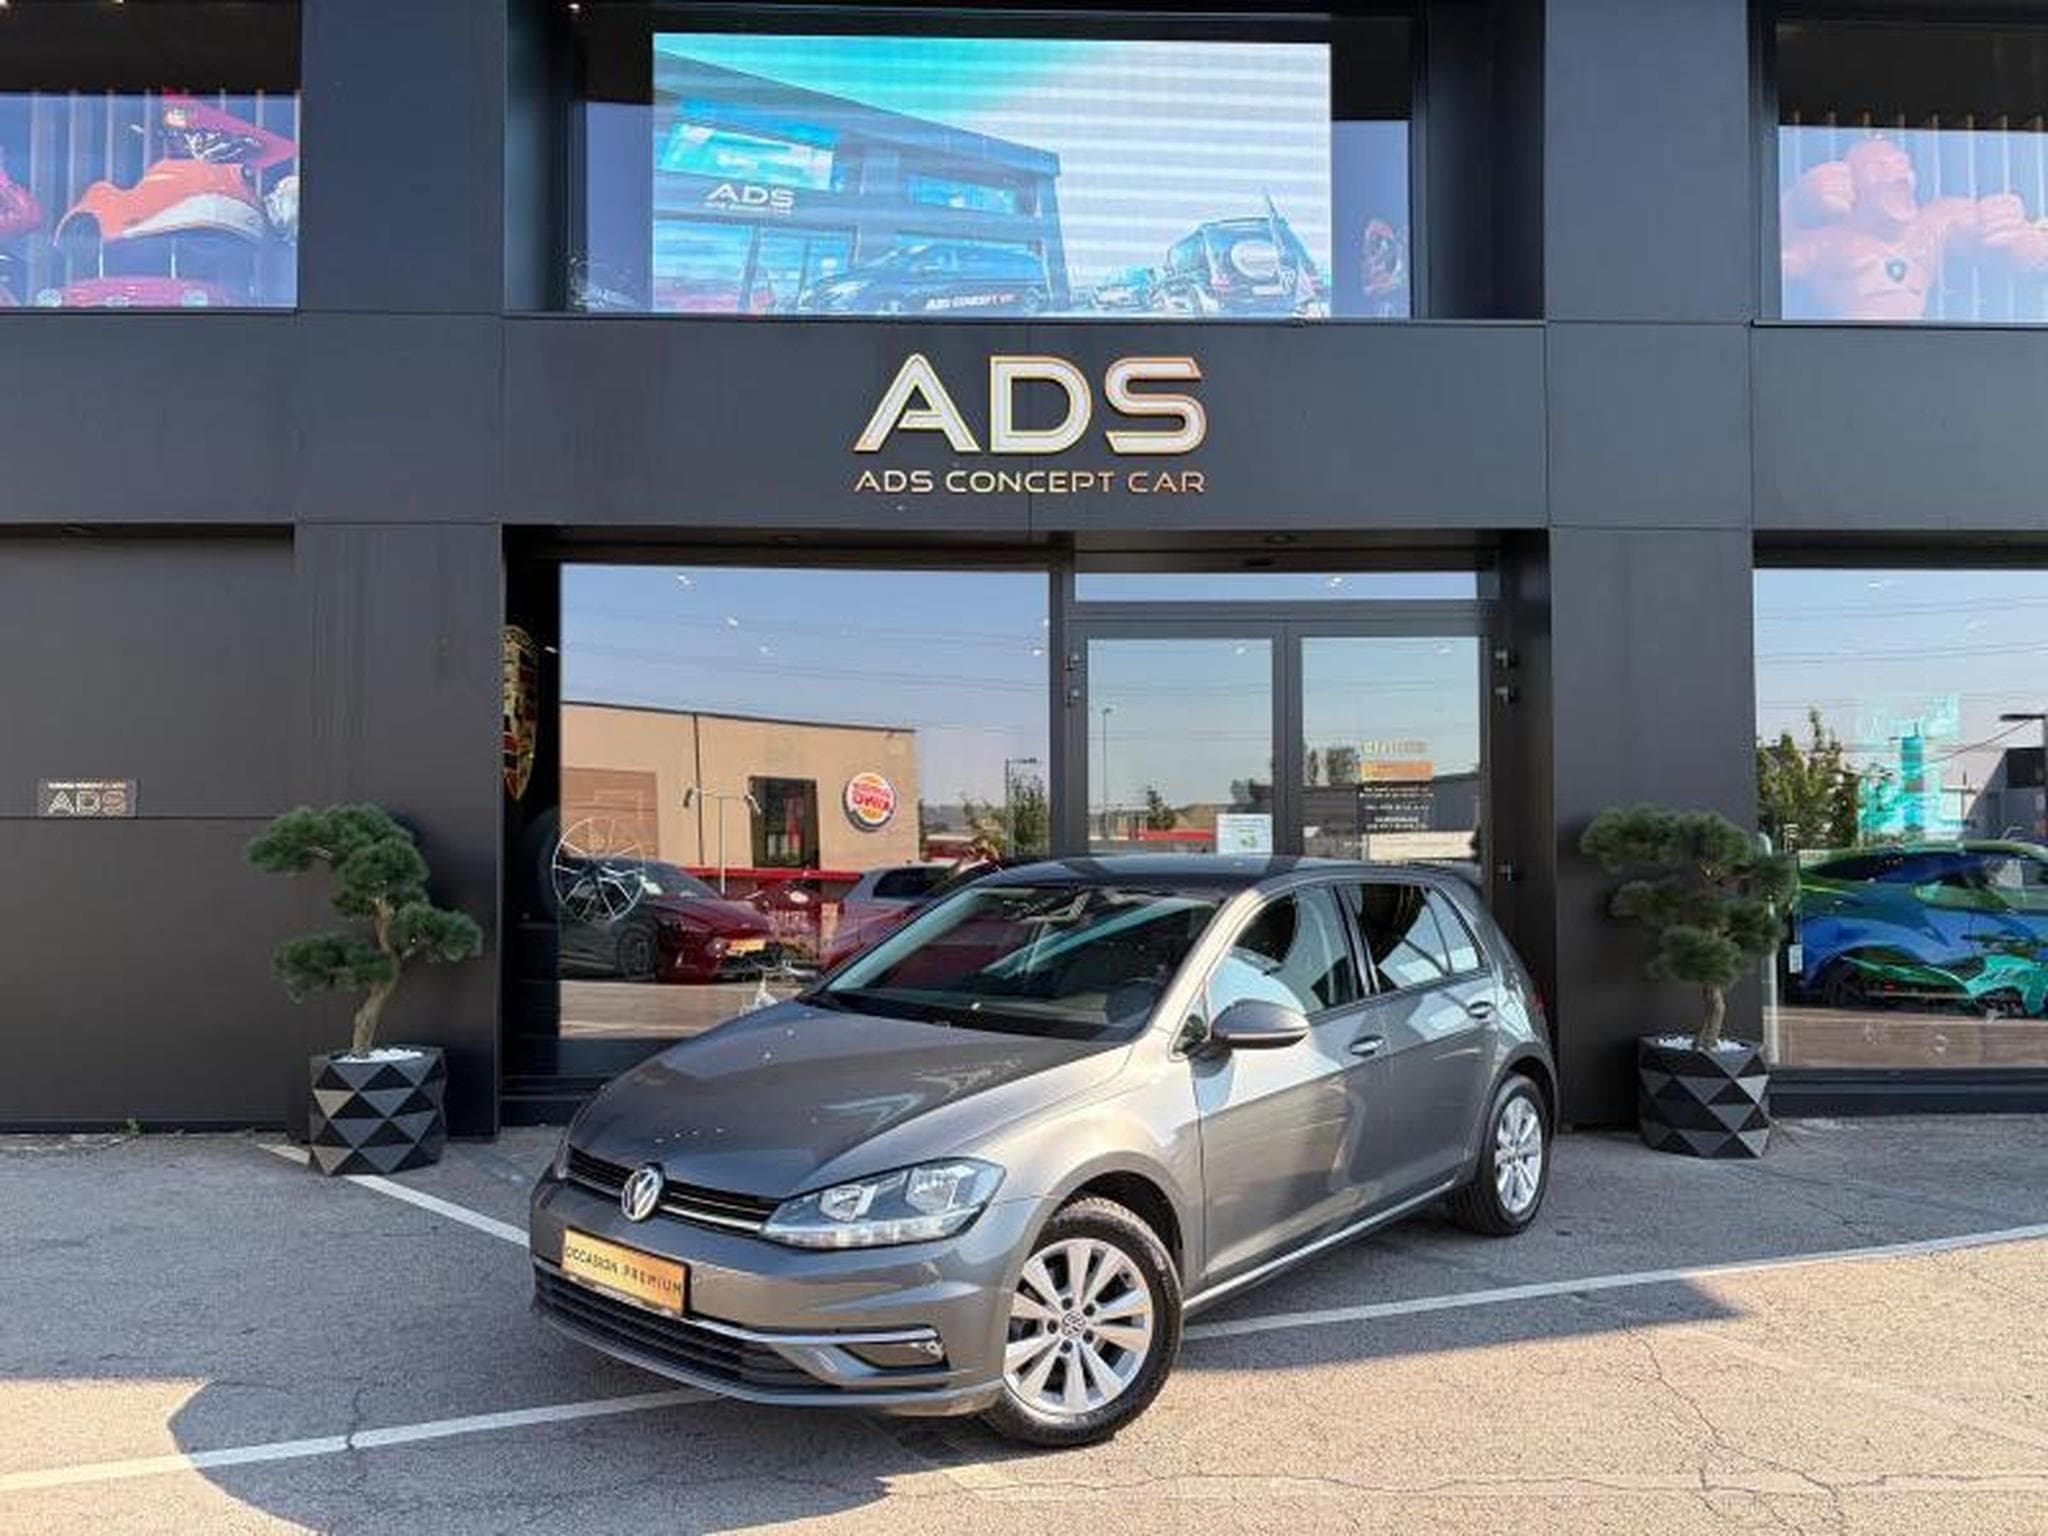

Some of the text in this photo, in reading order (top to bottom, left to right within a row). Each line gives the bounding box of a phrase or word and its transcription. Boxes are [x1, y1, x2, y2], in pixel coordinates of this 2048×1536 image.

[705, 183, 795, 208] ADS
[854, 353, 1207, 453] ADS
[855, 471, 1205, 493] ADS CONCEPT CAR
[48, 791, 126, 815] ADS
